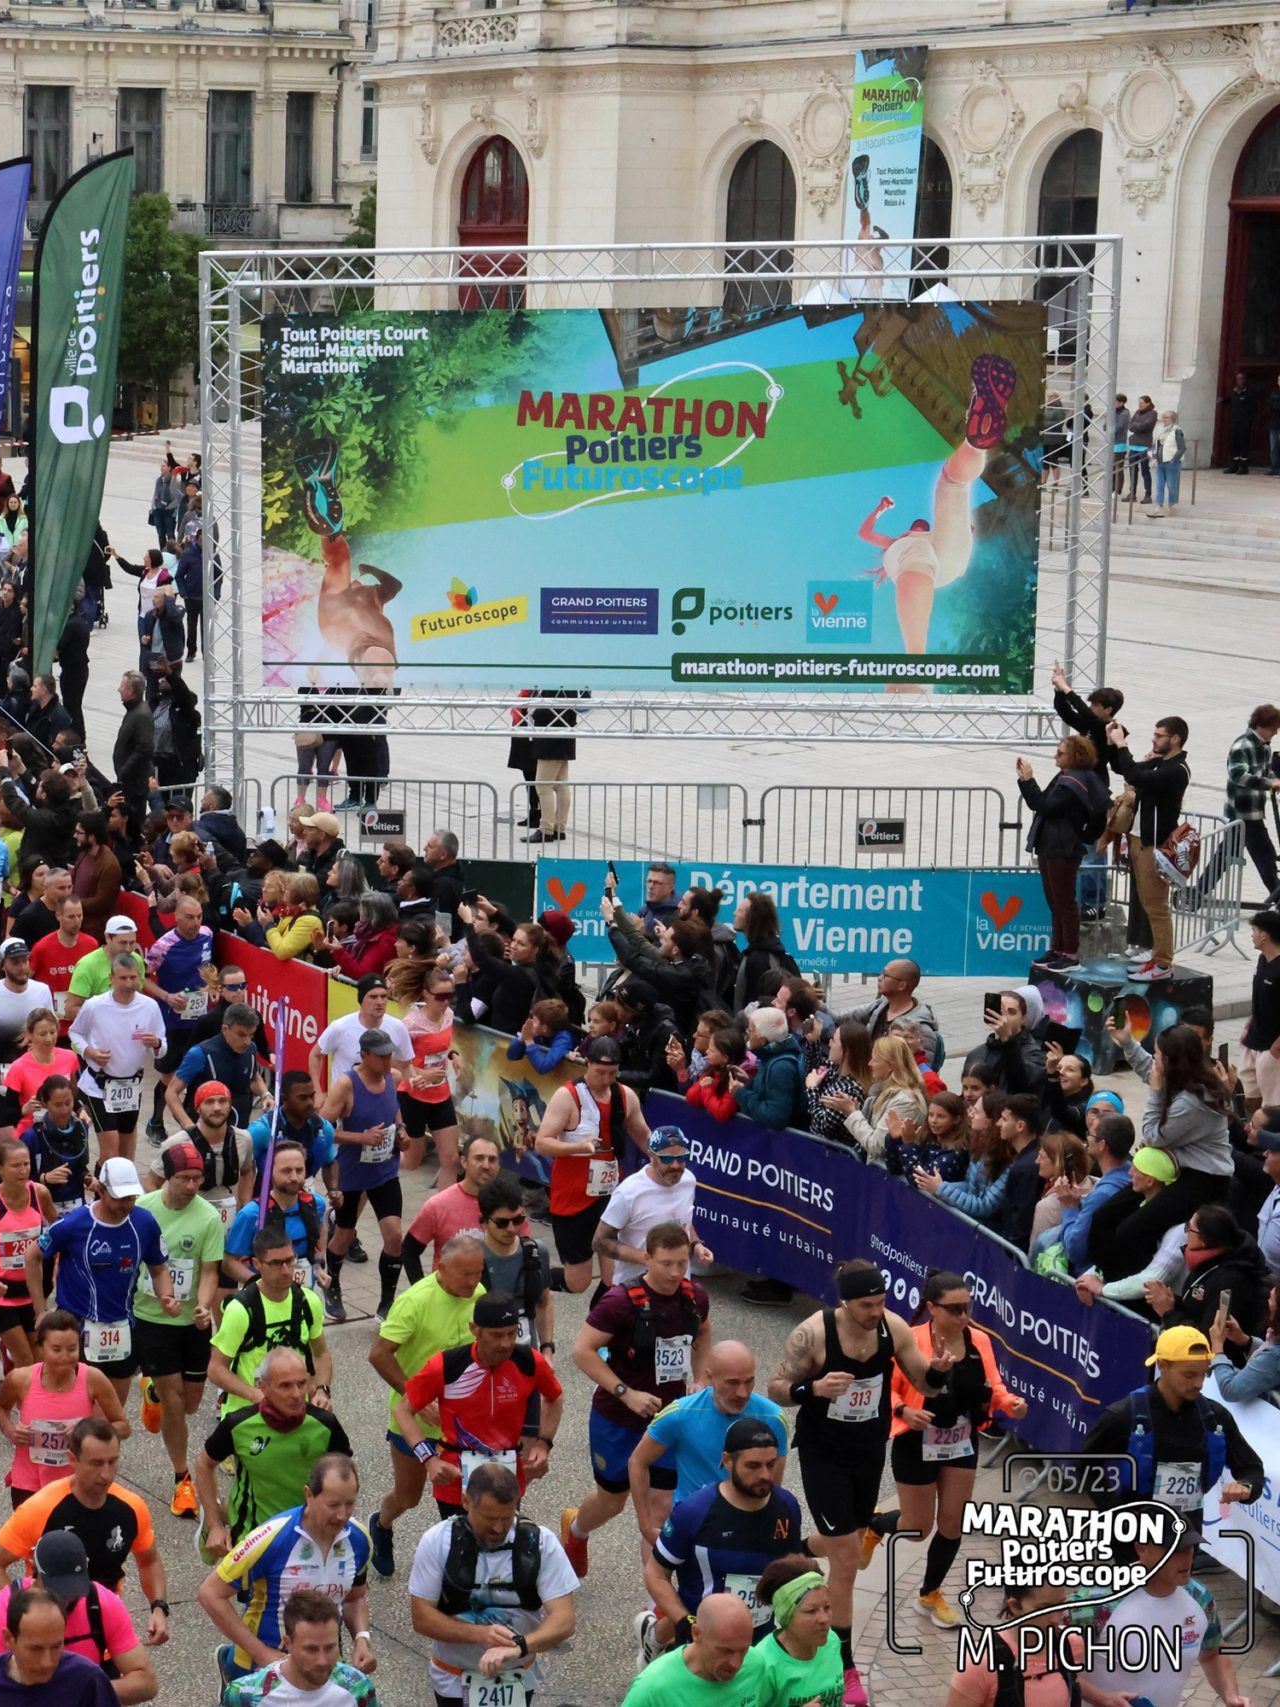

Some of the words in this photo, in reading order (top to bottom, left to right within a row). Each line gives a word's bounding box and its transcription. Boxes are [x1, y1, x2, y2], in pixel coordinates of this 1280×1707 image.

[862, 88, 918, 102] MARATHON
[871, 101, 903, 113] Poitiers
[75, 228, 101, 376] poitiers
[67, 330, 77, 347] de
[280, 327, 317, 342] Tout
[320, 326, 381, 342] Poitiers
[384, 325, 429, 341] Court
[280, 342, 404, 358] Semi-Marathon
[63, 348, 77, 377] ville
[281, 358, 360, 374] Marathon
[516, 390, 768, 439] MARATHON
[566, 431, 703, 466] Poitiers
[522, 460, 744, 496] Futuroscope
[551, 597, 593, 607] GRAND
[596, 597, 648, 607] POITIERS
[419, 604, 519, 636] futuroscope
[551, 618, 609, 626] communauté
[612, 618, 648, 626] urbaine
[709, 604, 793, 626] poitiers
[811, 616, 867, 629] vienne
[680, 657, 1000, 679] marathon-poitiers-futuroscope.com
[976, 915, 989, 931] la
[792, 917, 913, 955] Vienne
[976, 932, 1051, 951] vienn
[111, 1087, 134, 1100] 2470
[747, 1158, 834, 1212] POITIERS
[779, 1231, 834, 1264] urbaine
[100, 1331, 120, 1347] 314
[849, 1390, 872, 1407] 313
[935, 1427, 966, 1445] 2267
[232, 1525, 273, 1562] Gedimat
[478, 1682, 515, 1707] 2417
